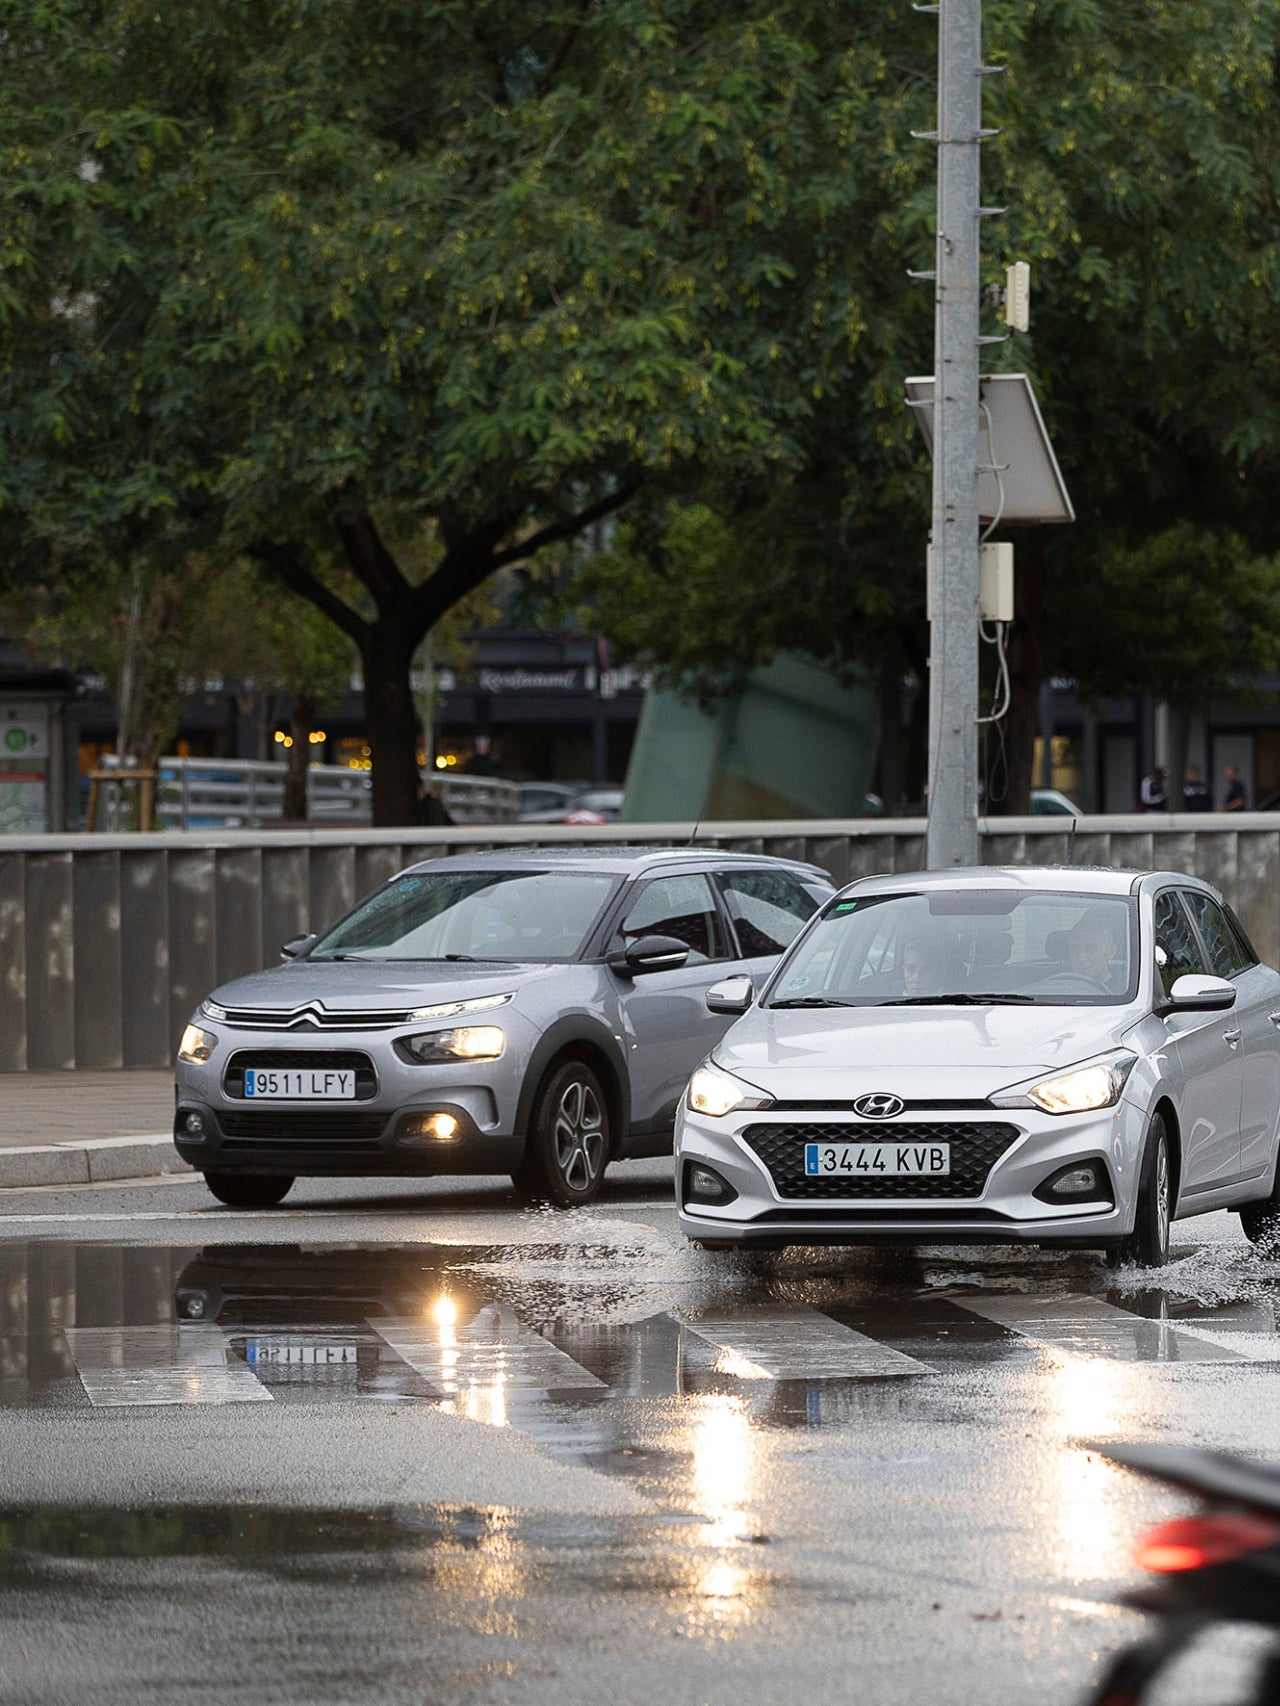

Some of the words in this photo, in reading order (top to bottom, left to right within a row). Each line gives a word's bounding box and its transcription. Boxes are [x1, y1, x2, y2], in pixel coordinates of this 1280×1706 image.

[257, 1073, 302, 1094] 9511
[311, 1073, 349, 1094] LFY
[823, 1148, 887, 1172] 3444
[896, 1148, 945, 1172] KVB
